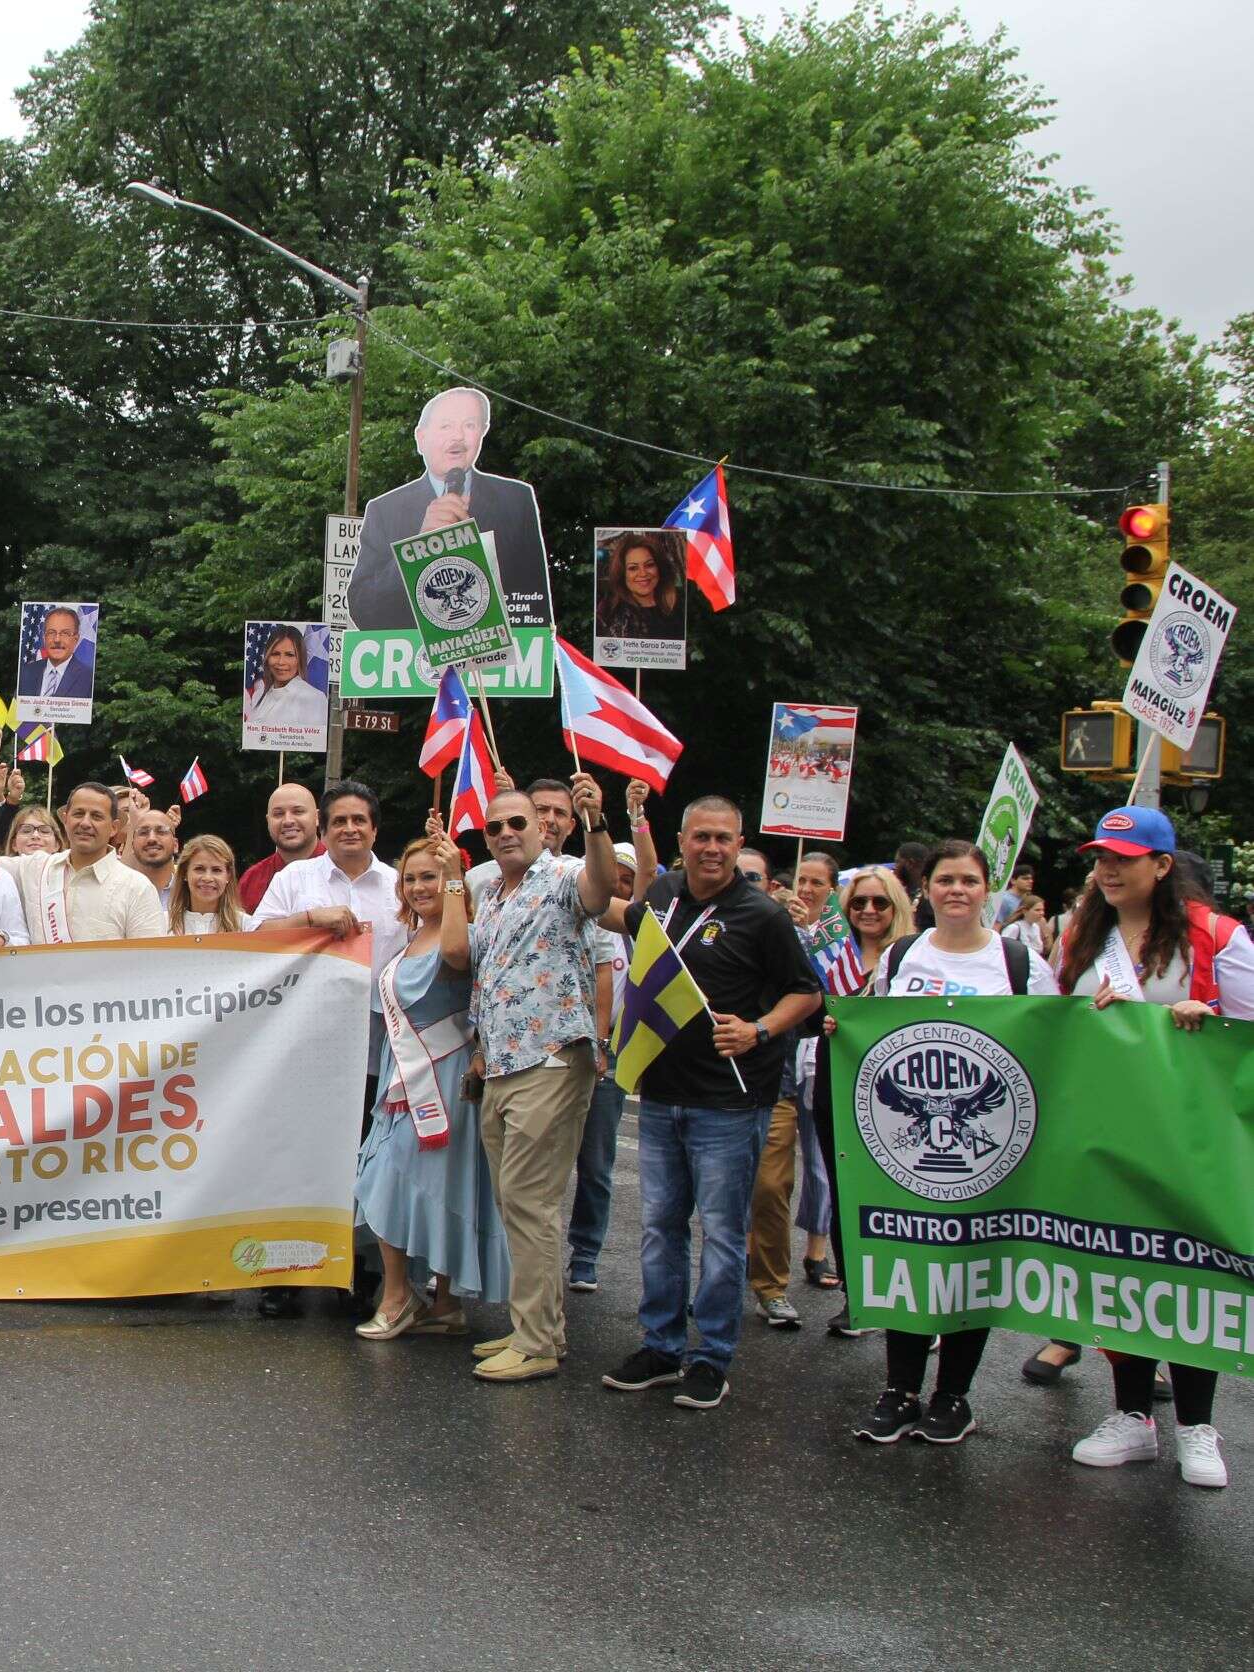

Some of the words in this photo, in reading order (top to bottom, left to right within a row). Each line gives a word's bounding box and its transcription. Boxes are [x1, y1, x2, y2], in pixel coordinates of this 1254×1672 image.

[400, 525, 478, 563] CROEM
[429, 567, 465, 588] CROEM
[506, 603, 531, 612] OEM
[511, 591, 544, 601] Tirado
[1168, 573, 1230, 633] CROEM
[523, 614, 544, 624] Rico
[428, 628, 497, 657] MAYAGÜEZ
[439, 648, 467, 662] CLASE
[469, 642, 492, 654] 1985
[472, 652, 507, 665] arade
[350, 636, 544, 688] CRM
[1130, 678, 1186, 725] MAYAGÜEZ
[1132, 698, 1158, 722] CLASE
[1159, 716, 1176, 735] 1972
[261, 725, 287, 733] Elizabeth
[288, 726, 303, 734] Rosa
[355, 714, 362, 728] E
[365, 715, 378, 729] 79
[381, 716, 392, 730] St
[1006, 757, 1035, 820] CROEM
[34, 996, 85, 1028] los
[913, 1026, 972, 1045] CENTRO
[159, 1041, 199, 1071] DE
[892, 1048, 981, 1091] CROEM
[973, 1037, 1032, 1113] RESIDENCIAL
[857, 1092, 869, 1112] DE
[1016, 1119, 1032, 1138] DE
[81, 1132, 199, 1176] RICO
[858, 1114, 914, 1188] EDUCATIVAS
[915, 1143, 1023, 1200] OPORTUNIDADES
[13, 1190, 163, 1230] presente!
[868, 1211, 963, 1242] CENTRO
[970, 1212, 1124, 1255] RESIDENCIAL
[1130, 1231, 1166, 1259] DE
[861, 1254, 918, 1313] LA
[928, 1256, 1080, 1322] MEJOR
